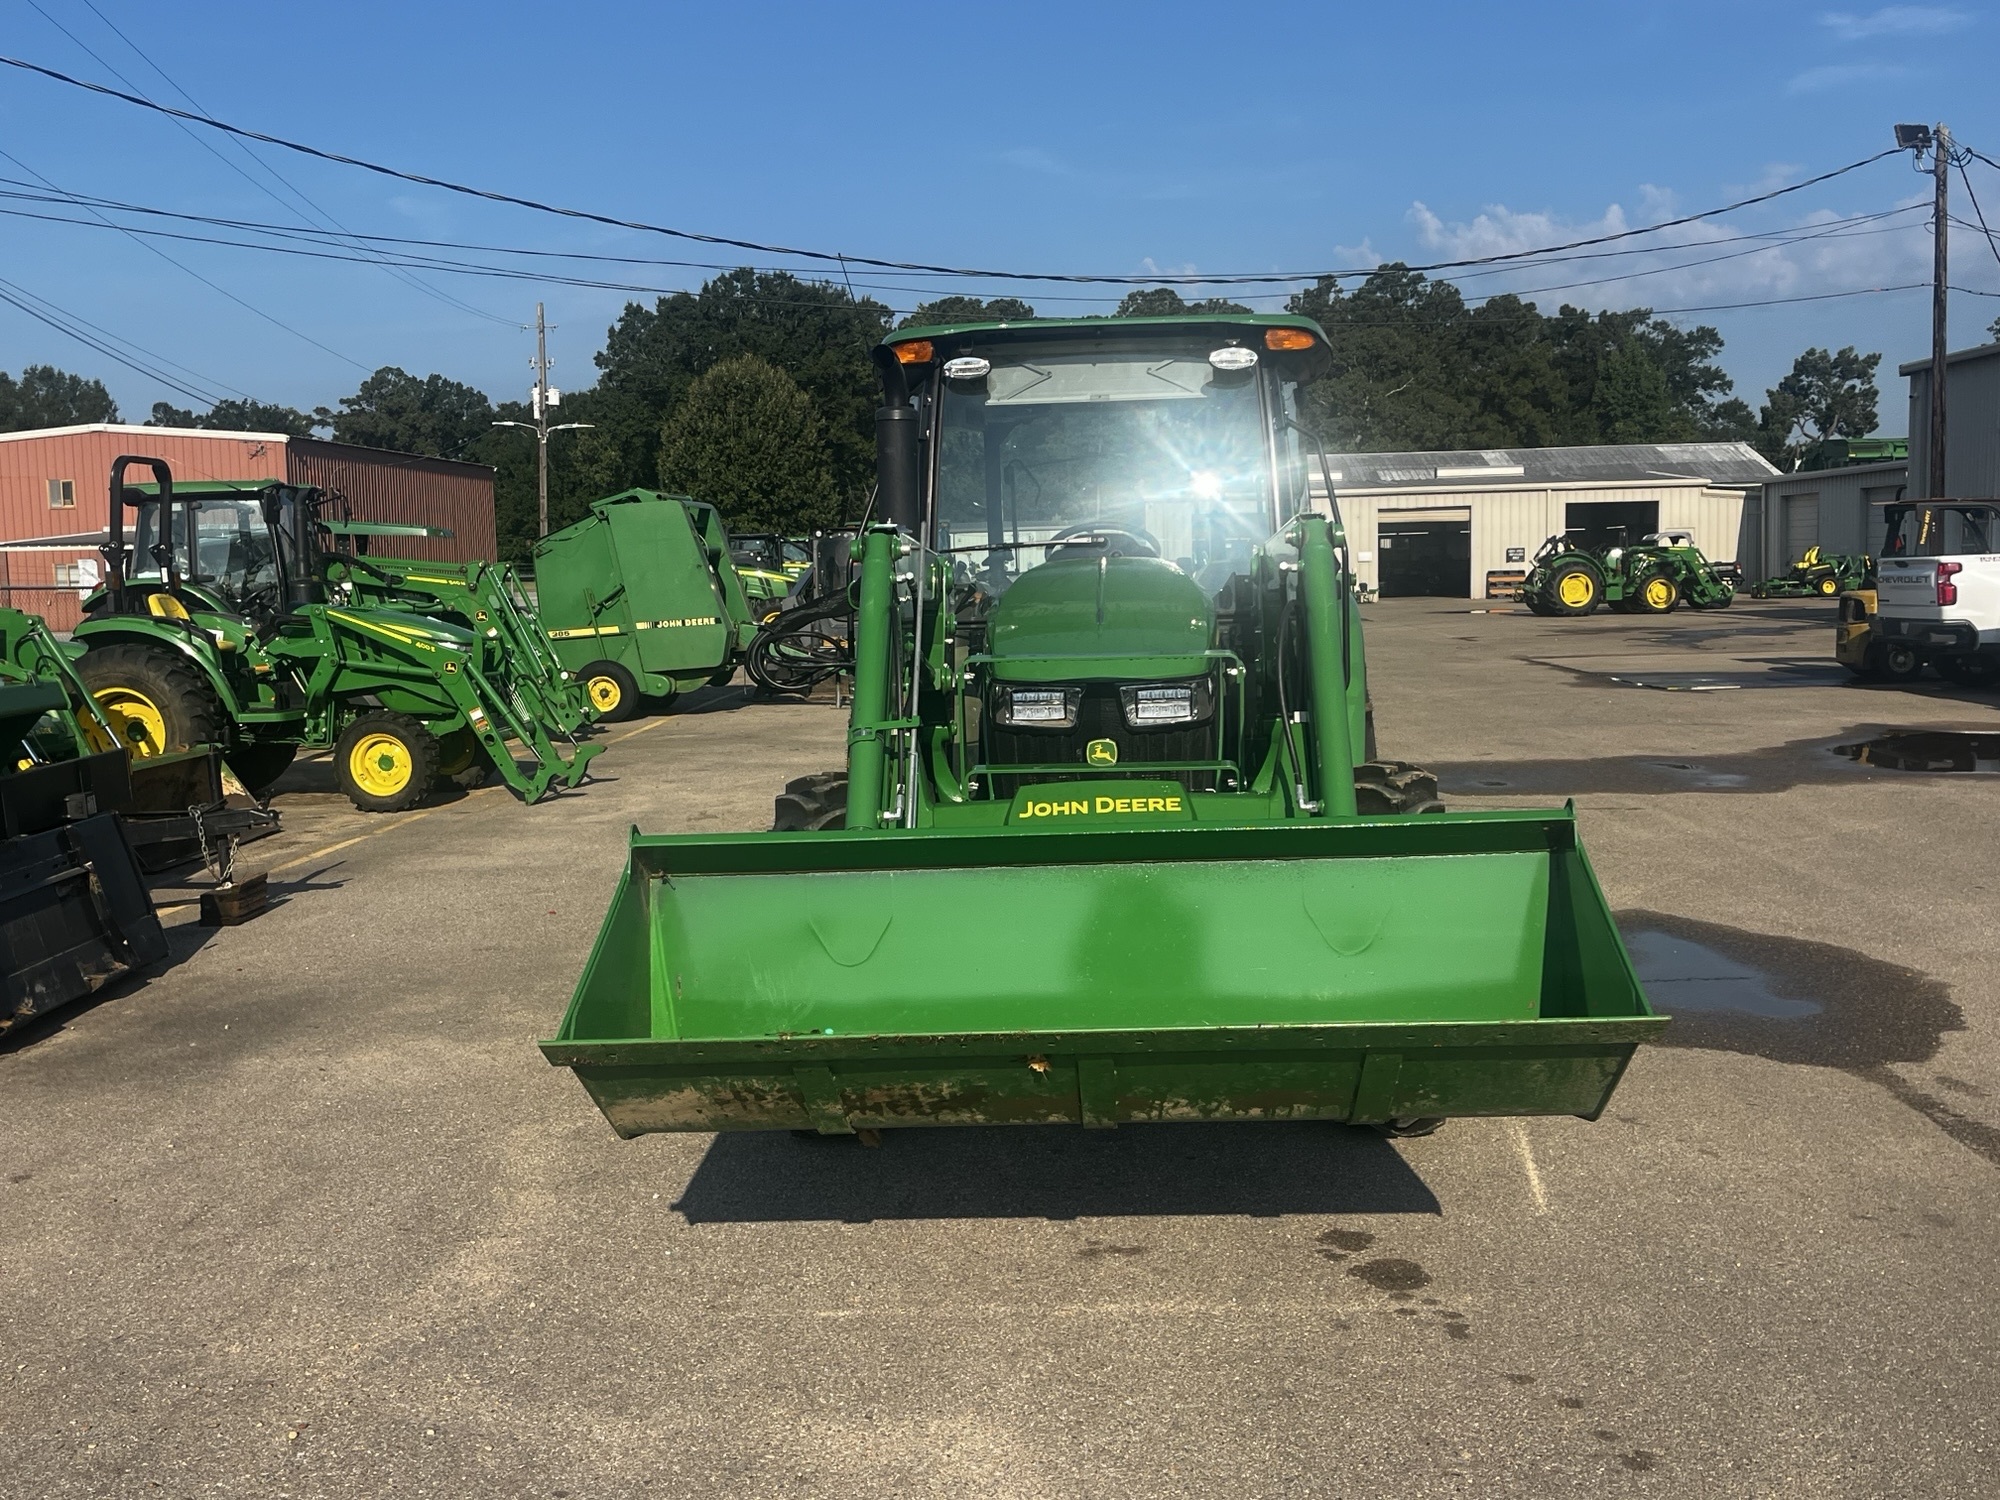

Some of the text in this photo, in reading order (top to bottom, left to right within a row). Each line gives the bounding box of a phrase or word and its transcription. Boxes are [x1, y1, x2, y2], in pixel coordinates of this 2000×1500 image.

[1878, 575, 1930, 584] CHEVROLET
[657, 617, 715, 629] JOHN DEERE
[1019, 797, 1182, 819] JOHN DEERE
